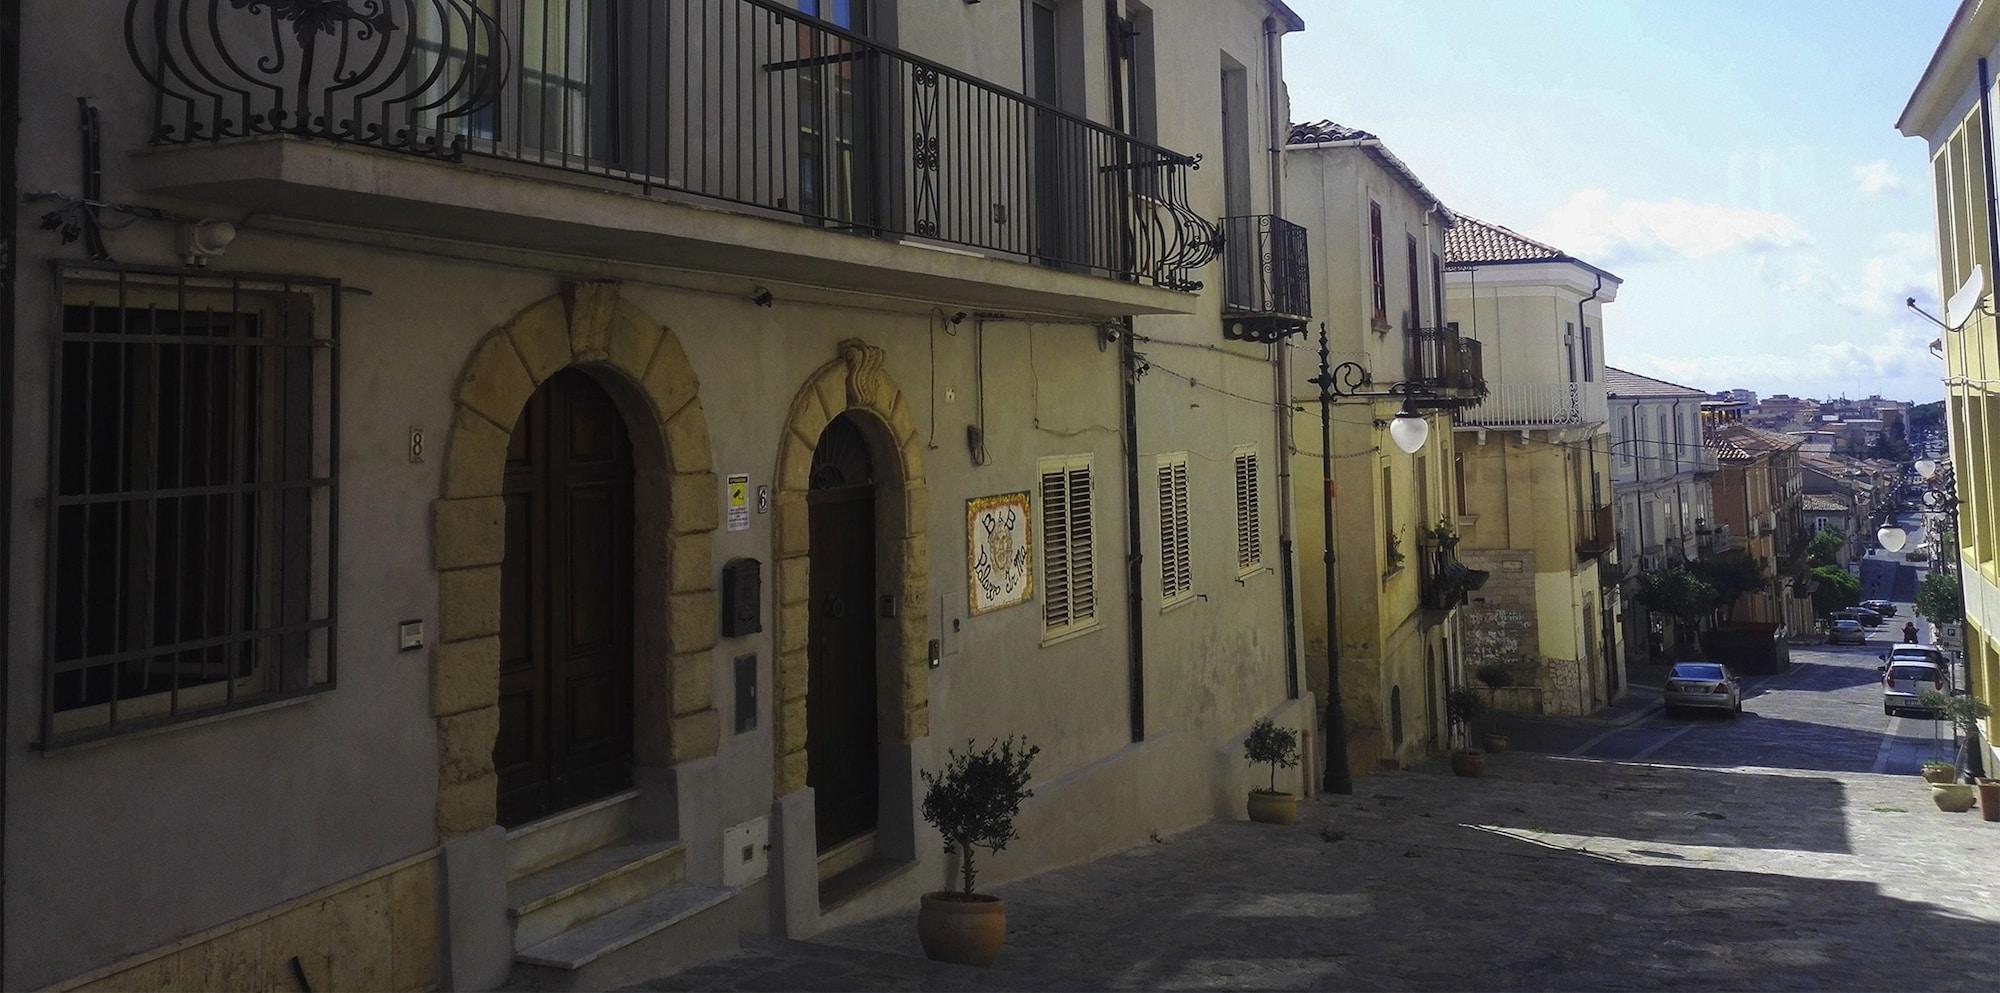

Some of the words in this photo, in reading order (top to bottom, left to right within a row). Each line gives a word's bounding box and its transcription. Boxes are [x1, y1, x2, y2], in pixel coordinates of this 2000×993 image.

[413, 432, 422, 456] 8
[760, 490, 767, 509] 6
[982, 513, 996, 537] B
[1004, 505, 1016, 531] B
[974, 544, 1001, 601] Palazzo
